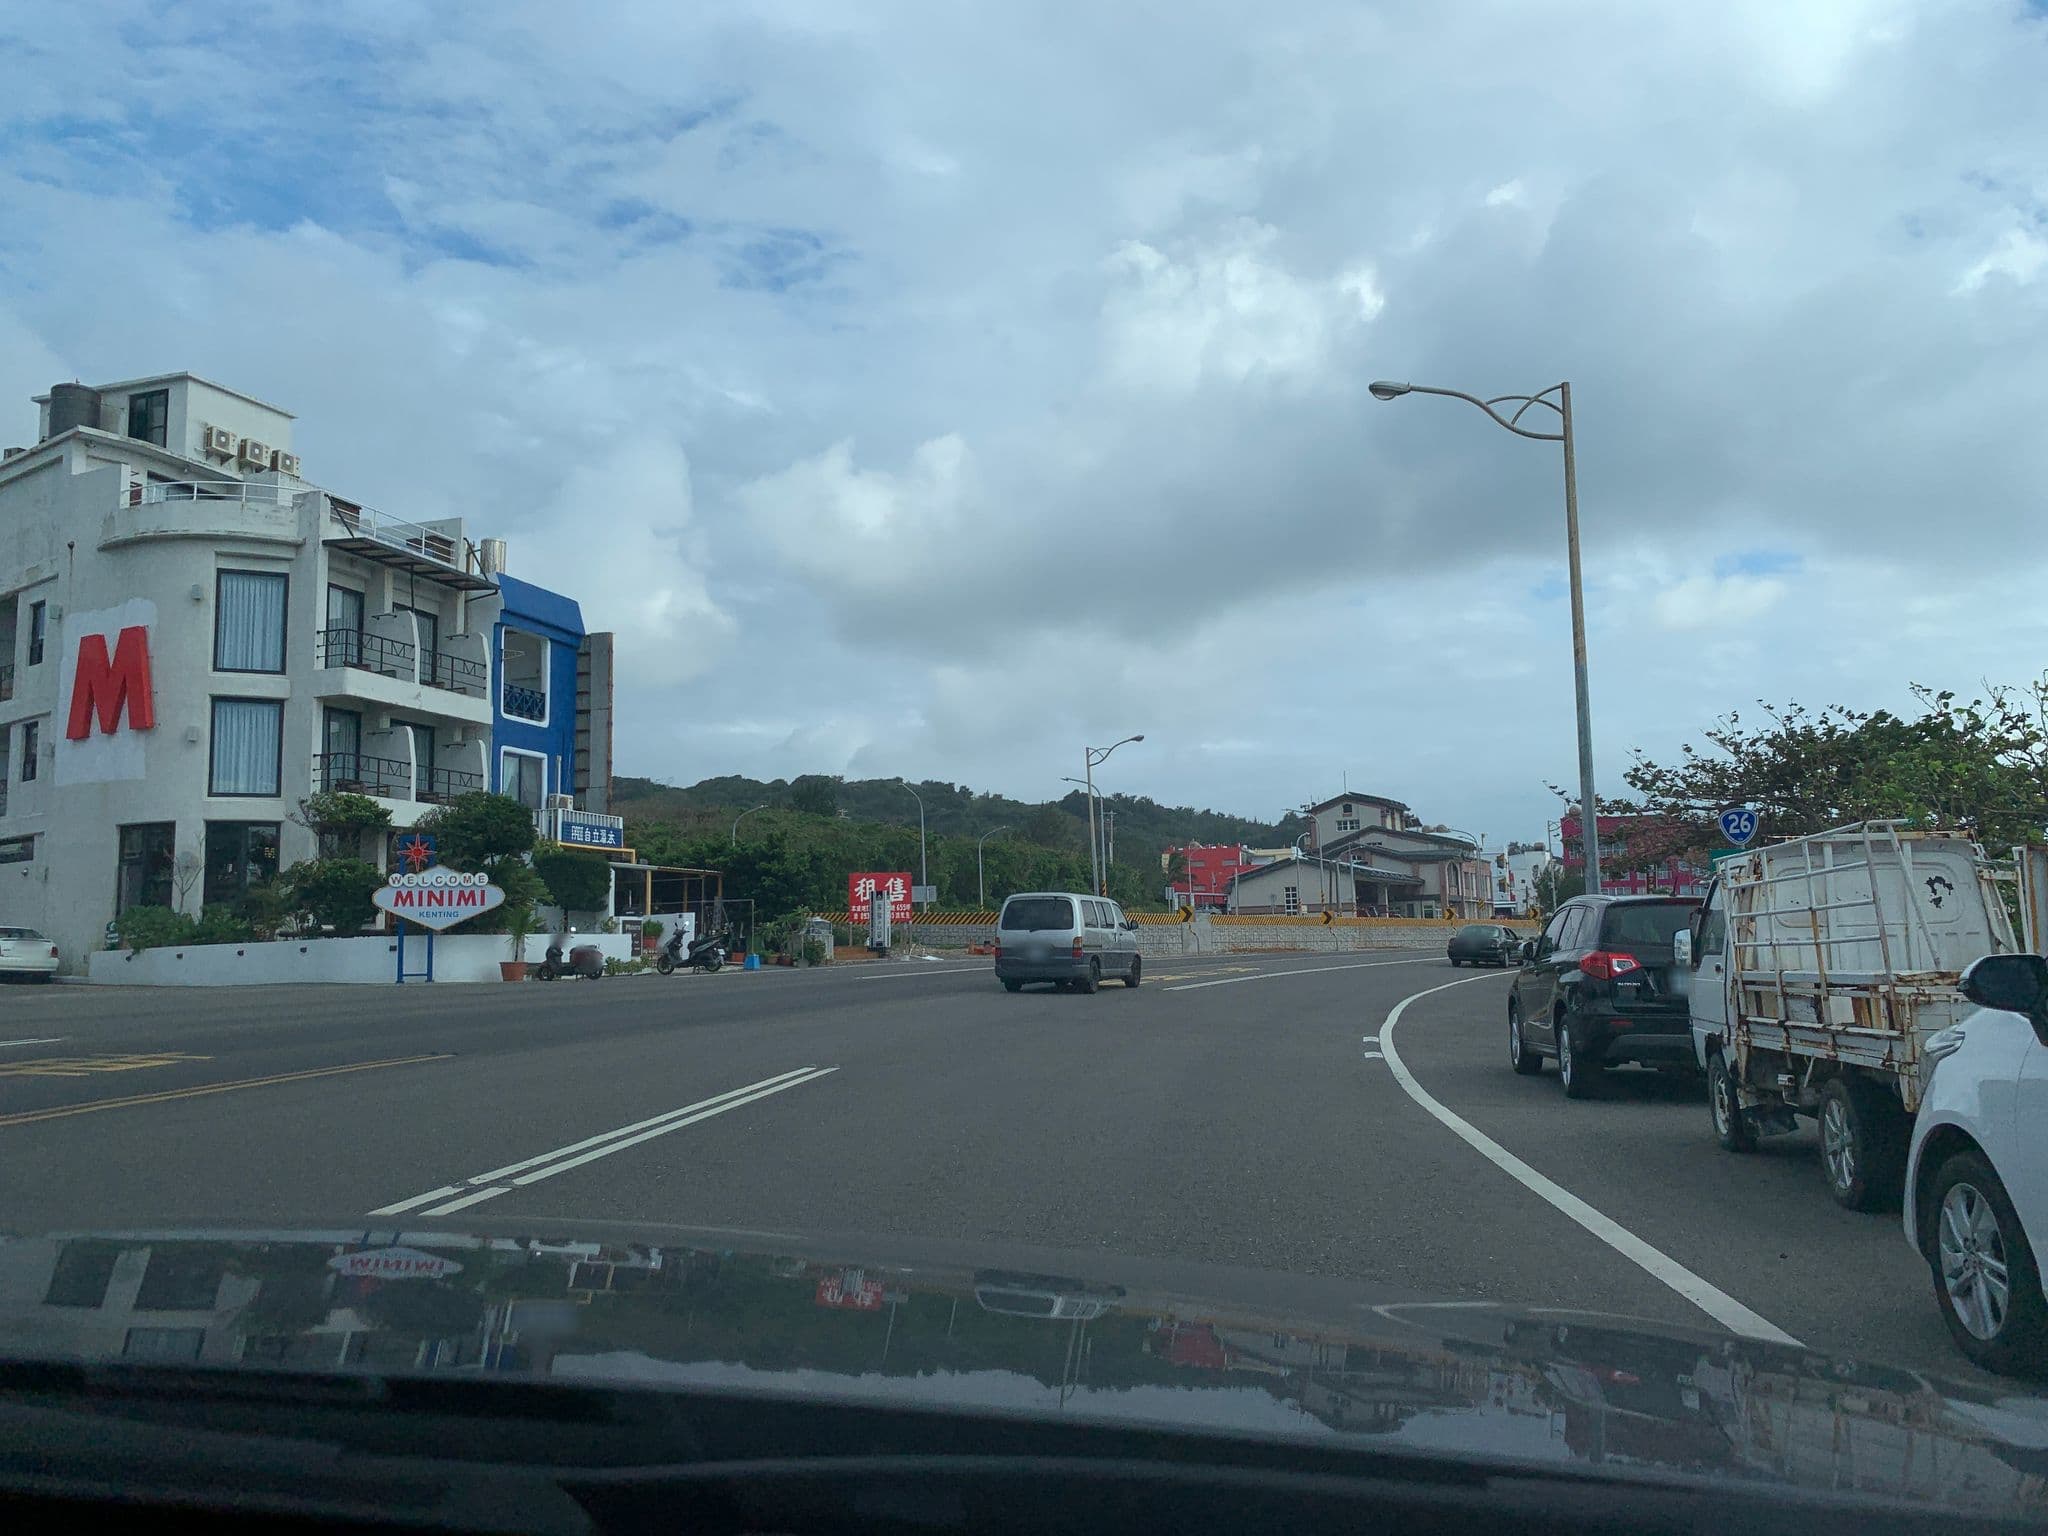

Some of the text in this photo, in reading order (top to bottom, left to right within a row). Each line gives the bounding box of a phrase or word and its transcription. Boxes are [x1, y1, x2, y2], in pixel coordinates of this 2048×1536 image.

[66, 625, 154, 740] M
[1728, 813, 1751, 834] 26
[390, 874, 486, 885] WELCOME
[393, 889, 486, 908] MINIMI
[854, 877, 907, 903] 租售
[418, 911, 460, 919] KENTING
